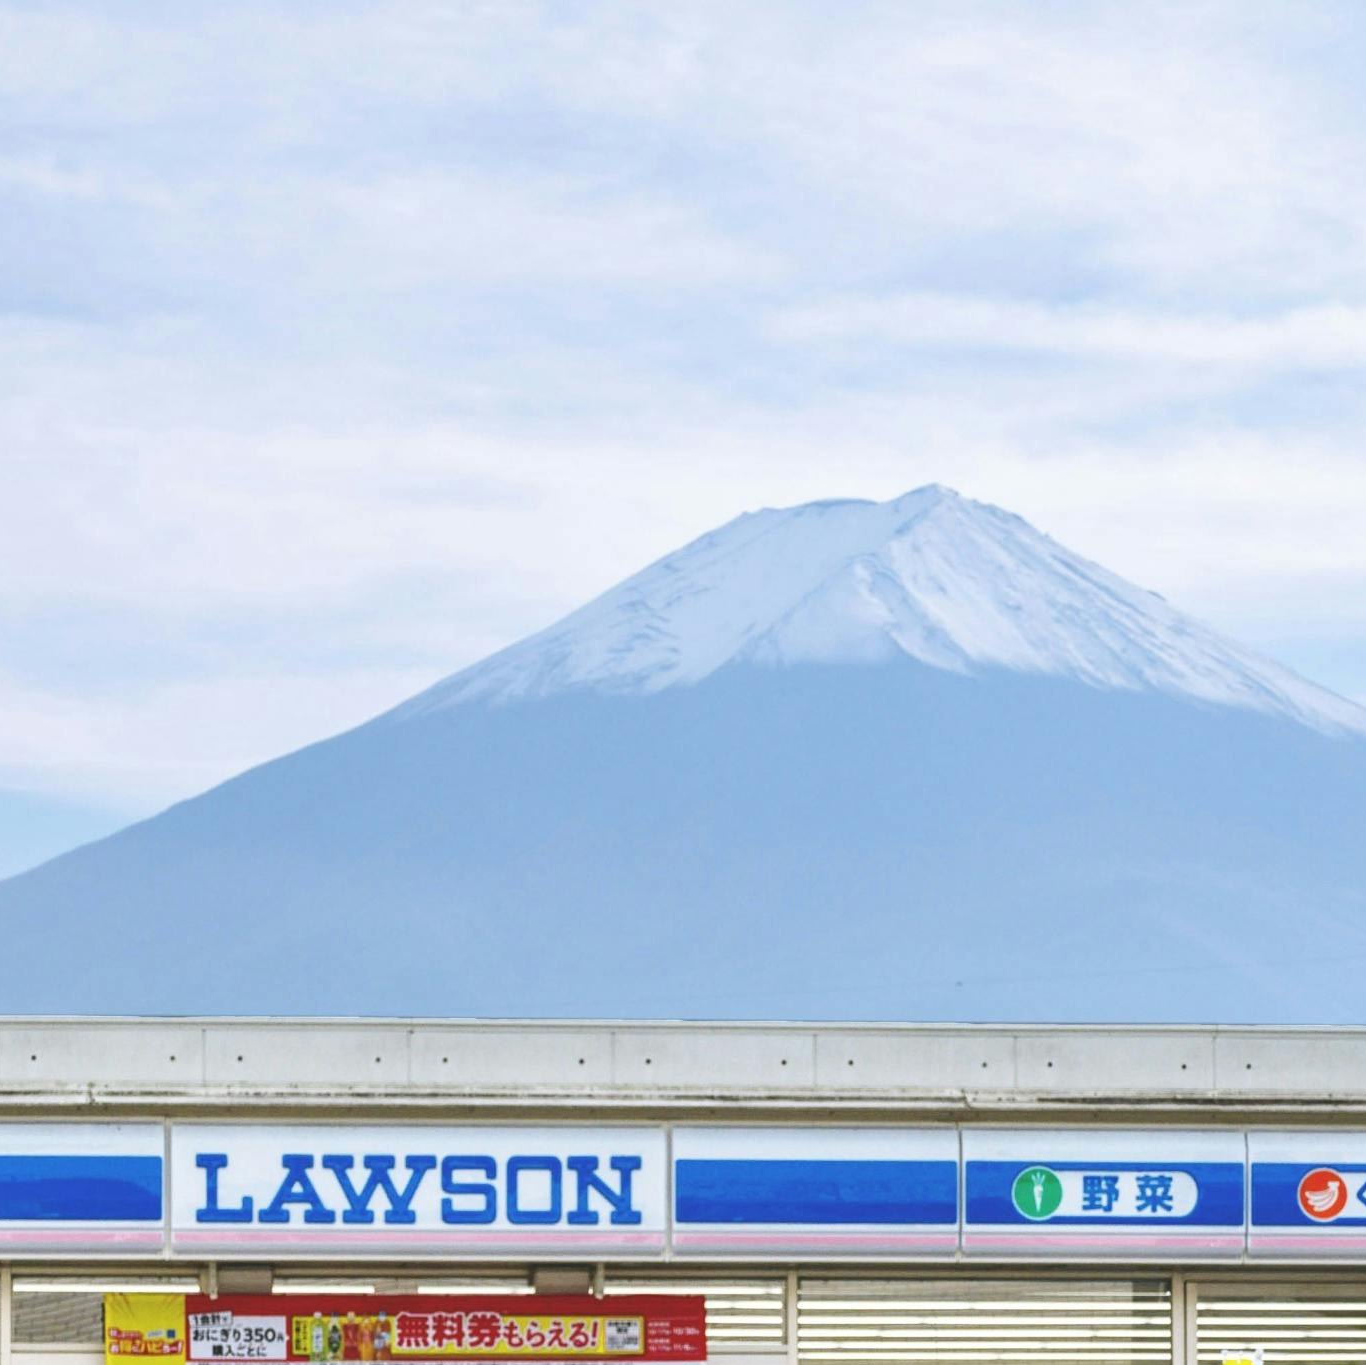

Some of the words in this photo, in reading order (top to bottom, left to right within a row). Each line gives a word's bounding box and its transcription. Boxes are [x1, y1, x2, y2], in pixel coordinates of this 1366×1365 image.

[195, 1152, 643, 1226] LAWSON
[1081, 1174, 1175, 1214] 野菜
[395, 1312, 598, 1348] 無料券もらえる!
